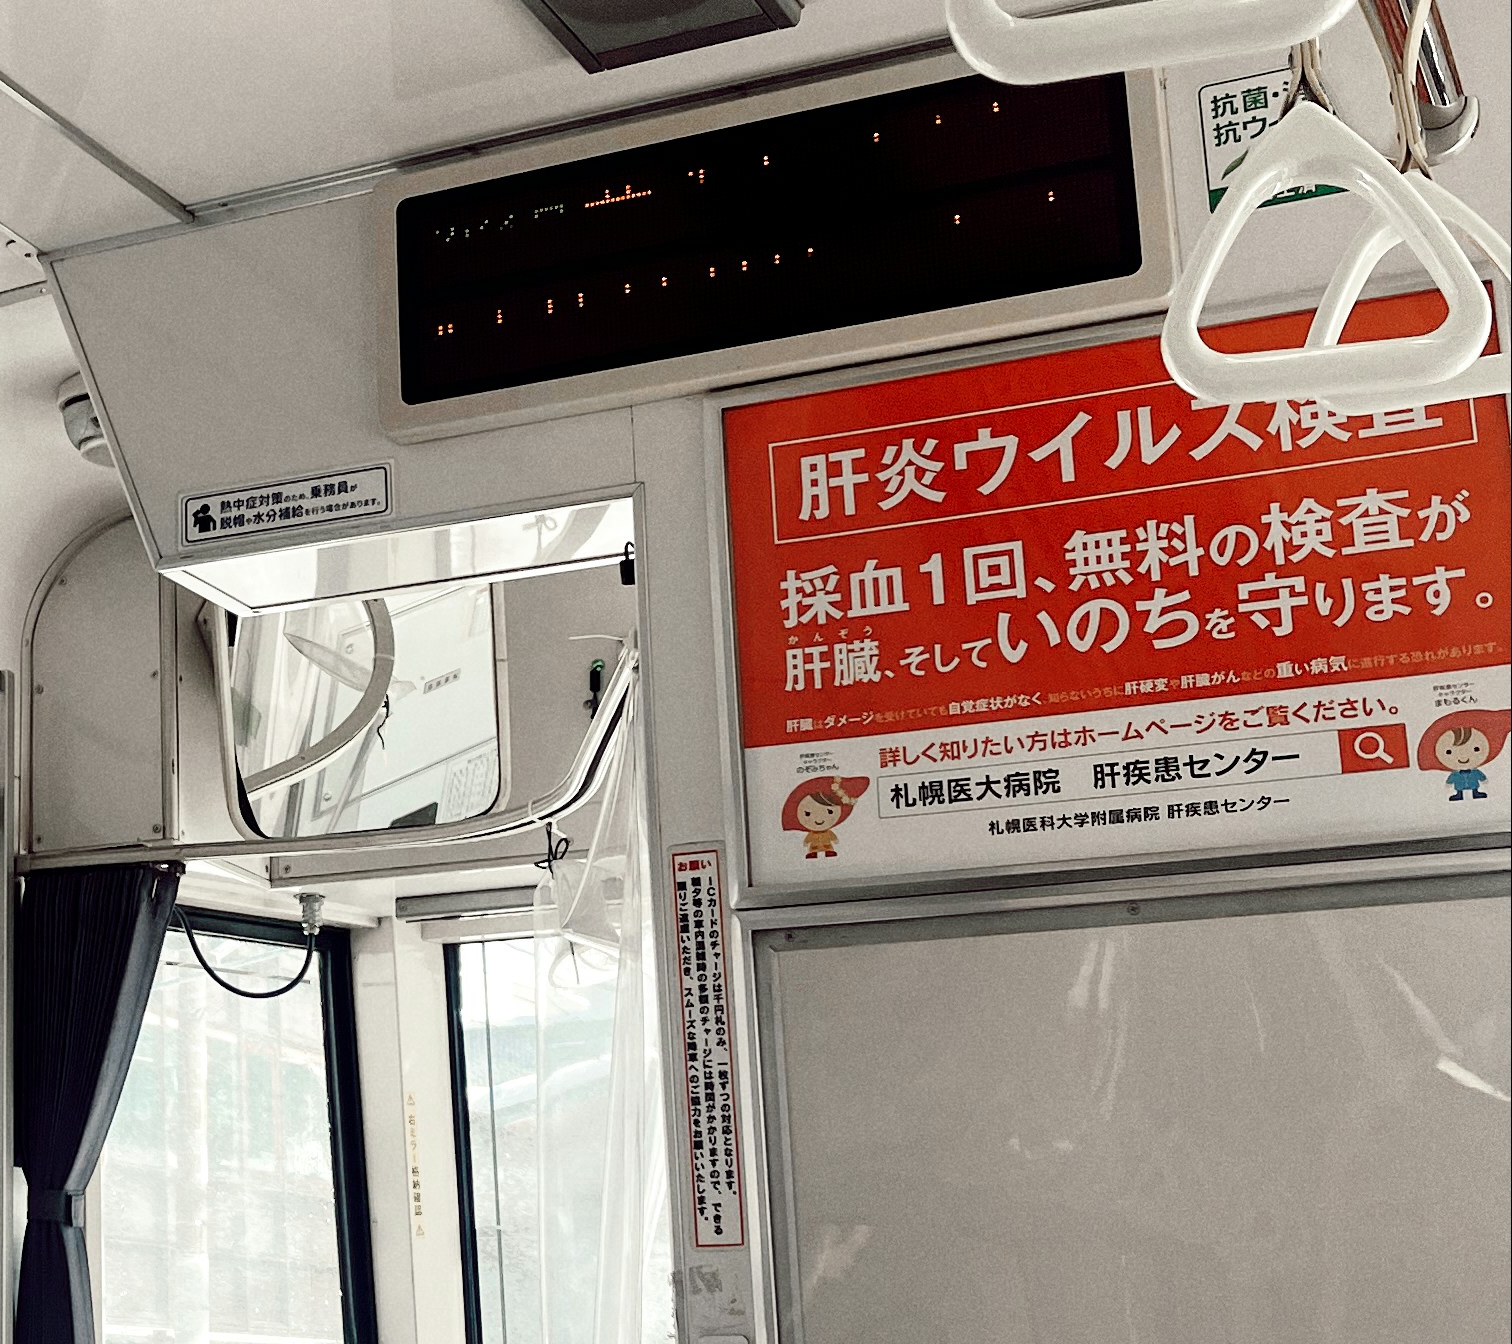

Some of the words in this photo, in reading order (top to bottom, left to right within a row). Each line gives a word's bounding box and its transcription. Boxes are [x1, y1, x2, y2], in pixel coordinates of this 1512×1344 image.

[219, 480, 358, 515] 熱中症対策のため、乗務員が
[780, 488, 1472, 629] 採血1回、無料の検査が
[784, 564, 1494, 693] 肝臓、そしていのちを守ります。
[788, 624, 874, 645] かんぞう
[878, 695, 1400, 769] 詳しく知りたい方はホームページをご覧ください。
[890, 768, 1062, 810] 札幌医大病院
[1092, 746, 1301, 790] 肝疾患センター
[988, 804, 1160, 837] 札幌医科大学附属病院
[1167, 794, 1291, 821] 肝疾患センター
